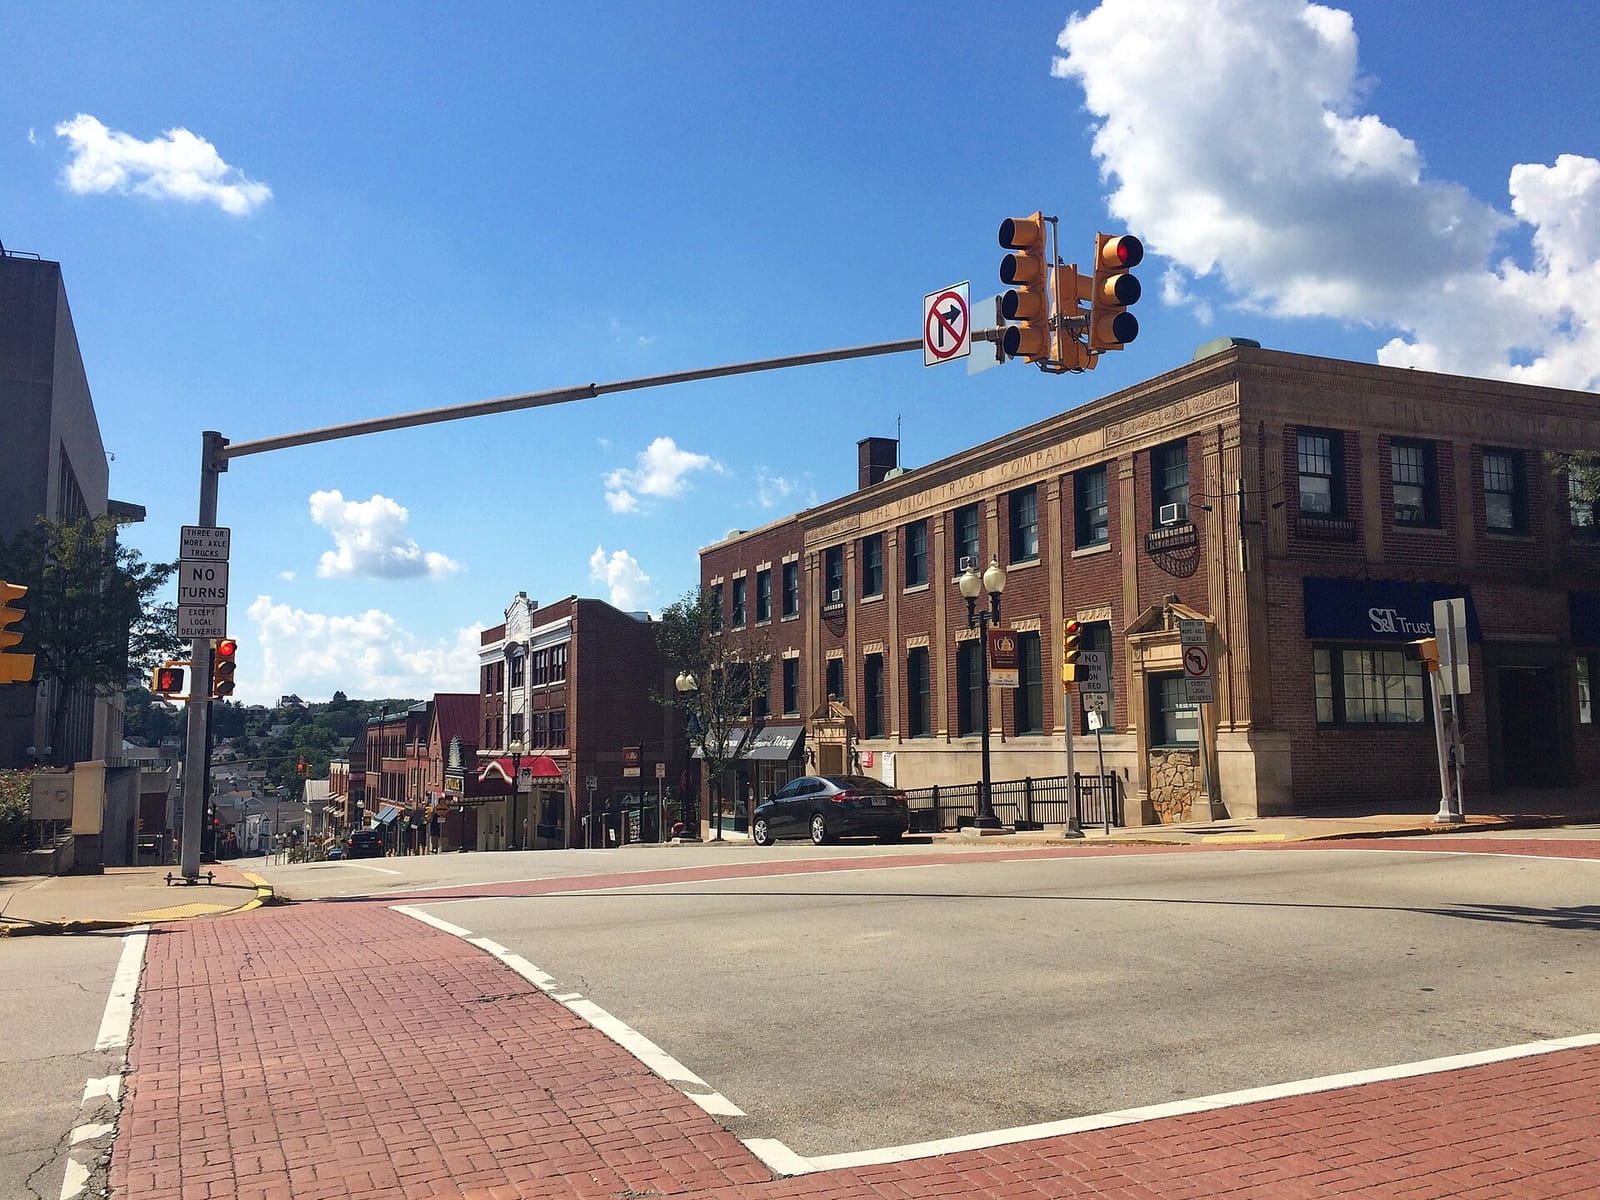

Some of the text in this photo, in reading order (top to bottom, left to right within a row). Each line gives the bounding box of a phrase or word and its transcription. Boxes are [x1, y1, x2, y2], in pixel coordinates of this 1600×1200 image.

[870, 507, 889, 522] THE
[1000, 437, 1082, 478] COMPANY
[186, 529, 210, 537] THREE
[183, 539, 226, 548] MORE AXLE
[191, 549, 219, 557] TRUCKS
[192, 568, 215, 581] NO
[181, 587, 225, 599] TURNS
[190, 618, 212, 626] LOCAL
[1368, 607, 1433, 634] S&T Trust
[1084, 654, 1098, 663] NO
[1087, 664, 1102, 672] URN
[1088, 673, 1098, 681] ON
[1087, 682, 1102, 690] RED
